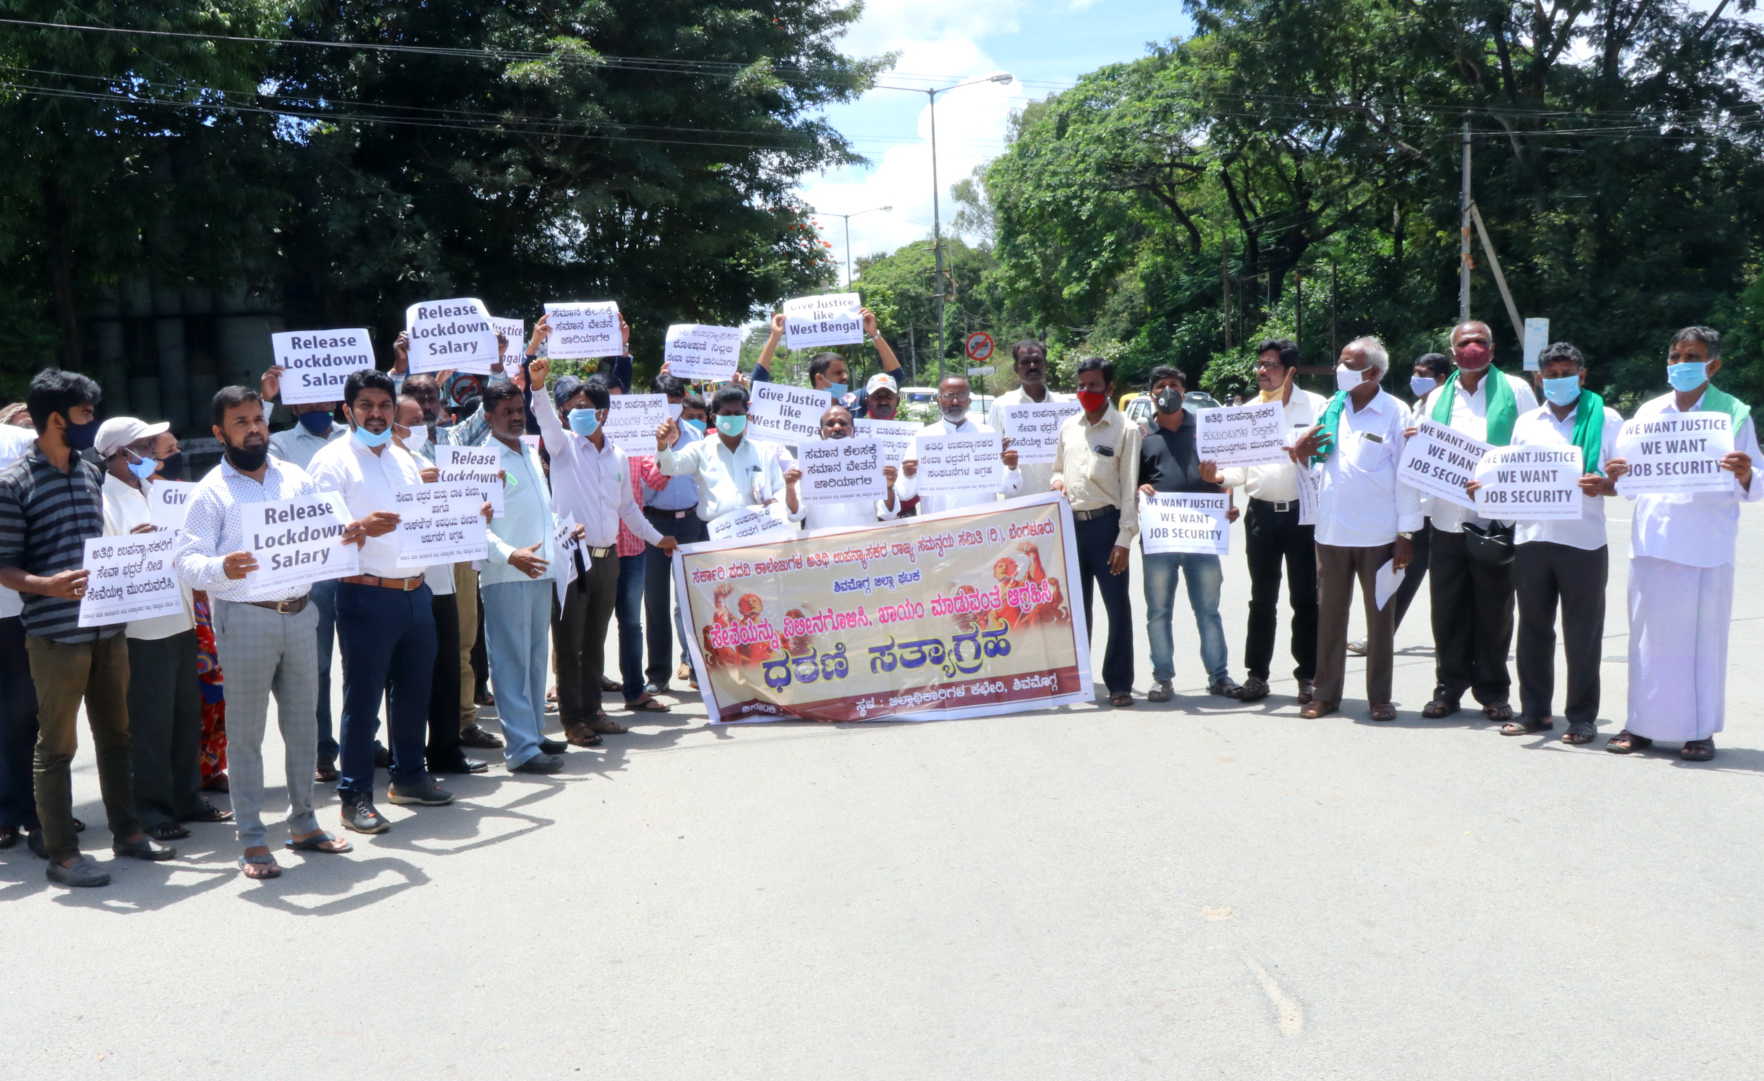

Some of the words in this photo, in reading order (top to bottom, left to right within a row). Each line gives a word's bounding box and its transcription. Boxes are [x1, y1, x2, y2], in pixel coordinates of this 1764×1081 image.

[817, 298, 854, 309] Justice
[418, 305, 478, 320] Release
[552, 307, 581, 318] ಸಮಾನ
[584, 306, 614, 320] ಕೆಲಸಕ್ಕೆ
[813, 310, 834, 321] like
[411, 321, 490, 339] Lockdown
[555, 319, 584, 331] ಸಮಾನ
[588, 318, 614, 329] ವೇತನ
[789, 323, 818, 335] West
[820, 319, 860, 333] Bengal
[291, 335, 357, 350] Release
[560, 332, 610, 345] ಜಾರಿಯಾಗಲಿ
[428, 340, 478, 356] Salary
[284, 353, 369, 370] Lockdown
[301, 372, 350, 387] Salar
[758, 387, 784, 401] Give
[786, 391, 827, 408] Justice
[779, 404, 802, 418] like
[752, 414, 781, 430] West
[783, 419, 821, 437] Benga
[1017, 423, 1037, 433] ಸೇವಾ
[1626, 423, 1641, 436] WE
[1643, 420, 1678, 434] WANT
[1680, 419, 1727, 432] JUSTICE
[1420, 423, 1435, 437] WE
[1436, 429, 1464, 448] WANT
[1463, 442, 1487, 458] JUST
[1640, 441, 1662, 455] WE
[1665, 438, 1707, 454] WANT
[451, 450, 496, 465] Release
[805, 446, 839, 460] ಸಮಾನ
[843, 443, 878, 460] ಕೆಲಸಕ್ಕೆ
[920, 455, 941, 465] ಸೇವಾ
[1427, 443, 1447, 461] WE
[1500, 452, 1531, 463] WANT
[1533, 451, 1576, 463] JUSTICE
[807, 461, 842, 475] ಸಮಾನ
[846, 459, 877, 472] ವೇತನ
[1407, 457, 1431, 474] JOB
[1430, 466, 1469, 489] SECUR
[1627, 463, 1653, 478] JOB
[1656, 459, 1722, 476] SECURITY
[814, 475, 872, 489] ಜಾರಿಯಾಗಲಿ
[1497, 470, 1517, 483] WE
[1520, 469, 1558, 483] WANT
[162, 488, 188, 505] Giv
[1146, 497, 1159, 506] WE
[1161, 498, 1188, 508] WANT
[1189, 499, 1225, 509] JUSTICE
[1484, 490, 1507, 503] JOB
[1511, 490, 1573, 503] SECURITY
[264, 502, 334, 525] Release
[1160, 512, 1176, 522] WE
[1179, 514, 1210, 524] WANT
[254, 523, 346, 551] Lockdown
[1149, 527, 1169, 539] JOB
[1172, 528, 1222, 541] SECURITY
[117, 537, 173, 561] ಉಪನ್ಯಾಸಕರಿಗೆ
[692, 566, 726, 585] ಸರ್ಕಾರಿ
[728, 561, 751, 579] ಪದವಿ
[754, 554, 803, 576] ಕಾಲೇಜುಗಳ
[833, 542, 888, 570] ಉಪನ್ಯಾಸಕರ
[891, 543, 916, 563] ರಾಜ್ಯ
[917, 533, 954, 558] ಸಮನ್ವಯ
[958, 529, 983, 547] ಸಮಿತಿ
[1008, 518, 1055, 540] ಬೆಂಗಳೂರು
[271, 547, 331, 571] Salary
[96, 565, 119, 579] ಸೇವಾ
[122, 560, 144, 578] ಭದ್ರತೆ
[145, 559, 163, 572] ನೀಡಿ
[87, 585, 124, 601] ಸೇವೆಯಲ್ಲಿ
[126, 577, 175, 596] ಮುಂದುವರೆಸಿ
[833, 576, 872, 595] ಶಿವಮೊಗ್ಗ
[874, 574, 895, 591] ಜಿಲ್ಲಾ
[897, 569, 921, 584] ಘಟಕ
[710, 618, 780, 650] ಸೇವೆಯನ್ನು
[877, 597, 925, 624] ಖಾಯಂ
[930, 584, 1003, 617] ಮಾಡುವಂತೆ
[1006, 579, 1053, 613] ಆಗ್ರಹಿಸಿ
[762, 641, 849, 694] ಧರಣಿ
[867, 617, 1012, 678] ಸತ್ಯಾಗ್ರಹ
[888, 685, 966, 710] ಜಿಲ್ಲಾಧಿಕಾರಿಗಳ
[1012, 672, 1059, 693] ಶಿವಮೊಗ್ಗ
